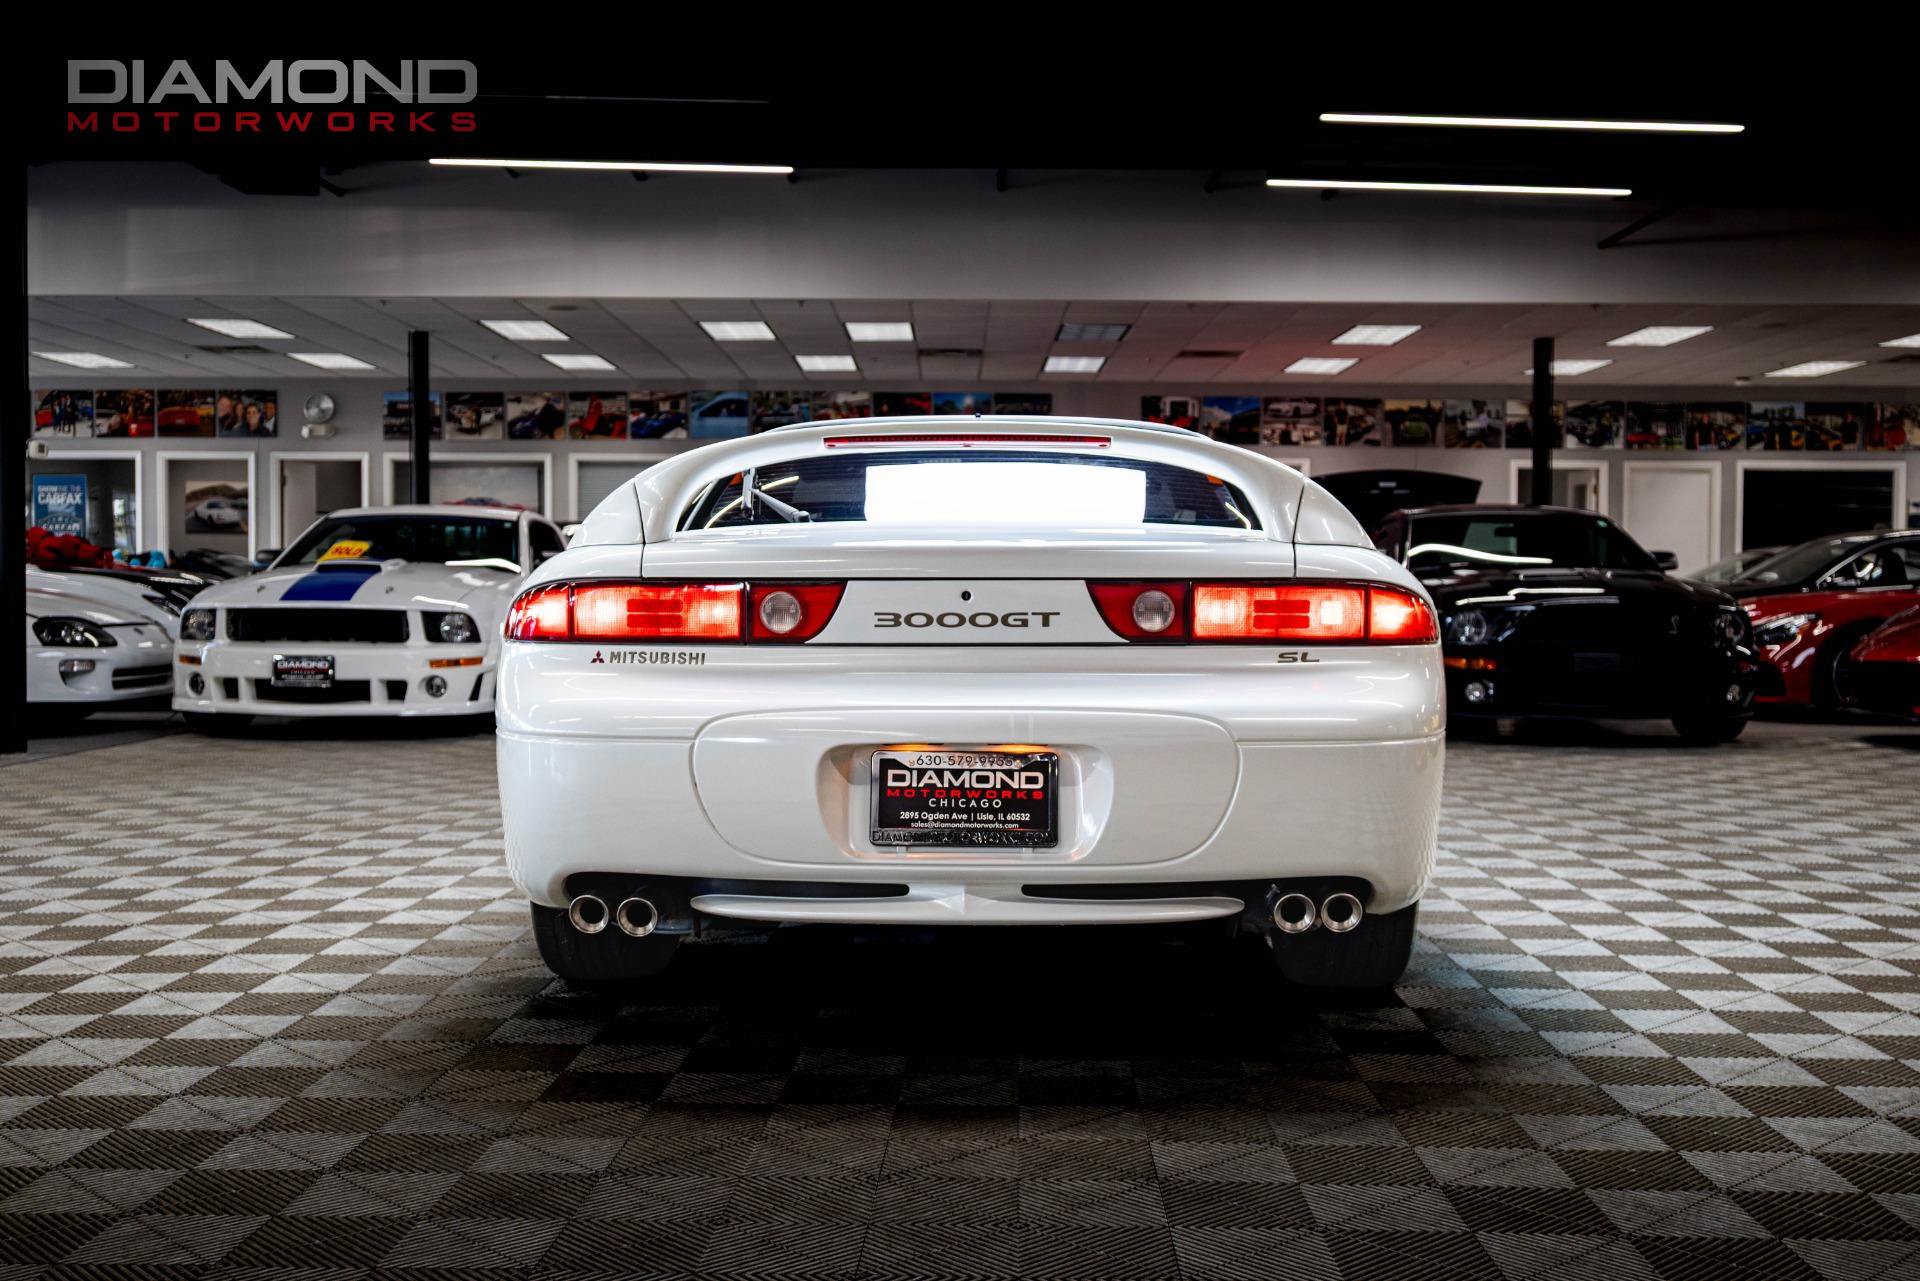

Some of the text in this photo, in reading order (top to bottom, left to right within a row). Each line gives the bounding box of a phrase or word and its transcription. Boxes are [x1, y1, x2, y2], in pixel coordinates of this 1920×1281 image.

[38, 492, 82, 505] CARFAX
[874, 611, 1061, 628] 3000GT
[609, 651, 706, 665] MITSUBISHI
[1277, 651, 1320, 663] SL
[277, 660, 329, 669] DIAMOND
[887, 769, 1044, 789] DIAMOND
[887, 789, 1044, 799] MOTORWORKS
[928, 799, 1002, 808] CHICAGO
[900, 811, 919, 820] 2895
[921, 811, 950, 821] Ogden
[951, 812, 968, 820] Ave
[976, 813, 996, 821] Lisle,
[1006, 813, 1031, 821] 60532
[911, 821, 1019, 829] sales@diamondmotorworks.com
